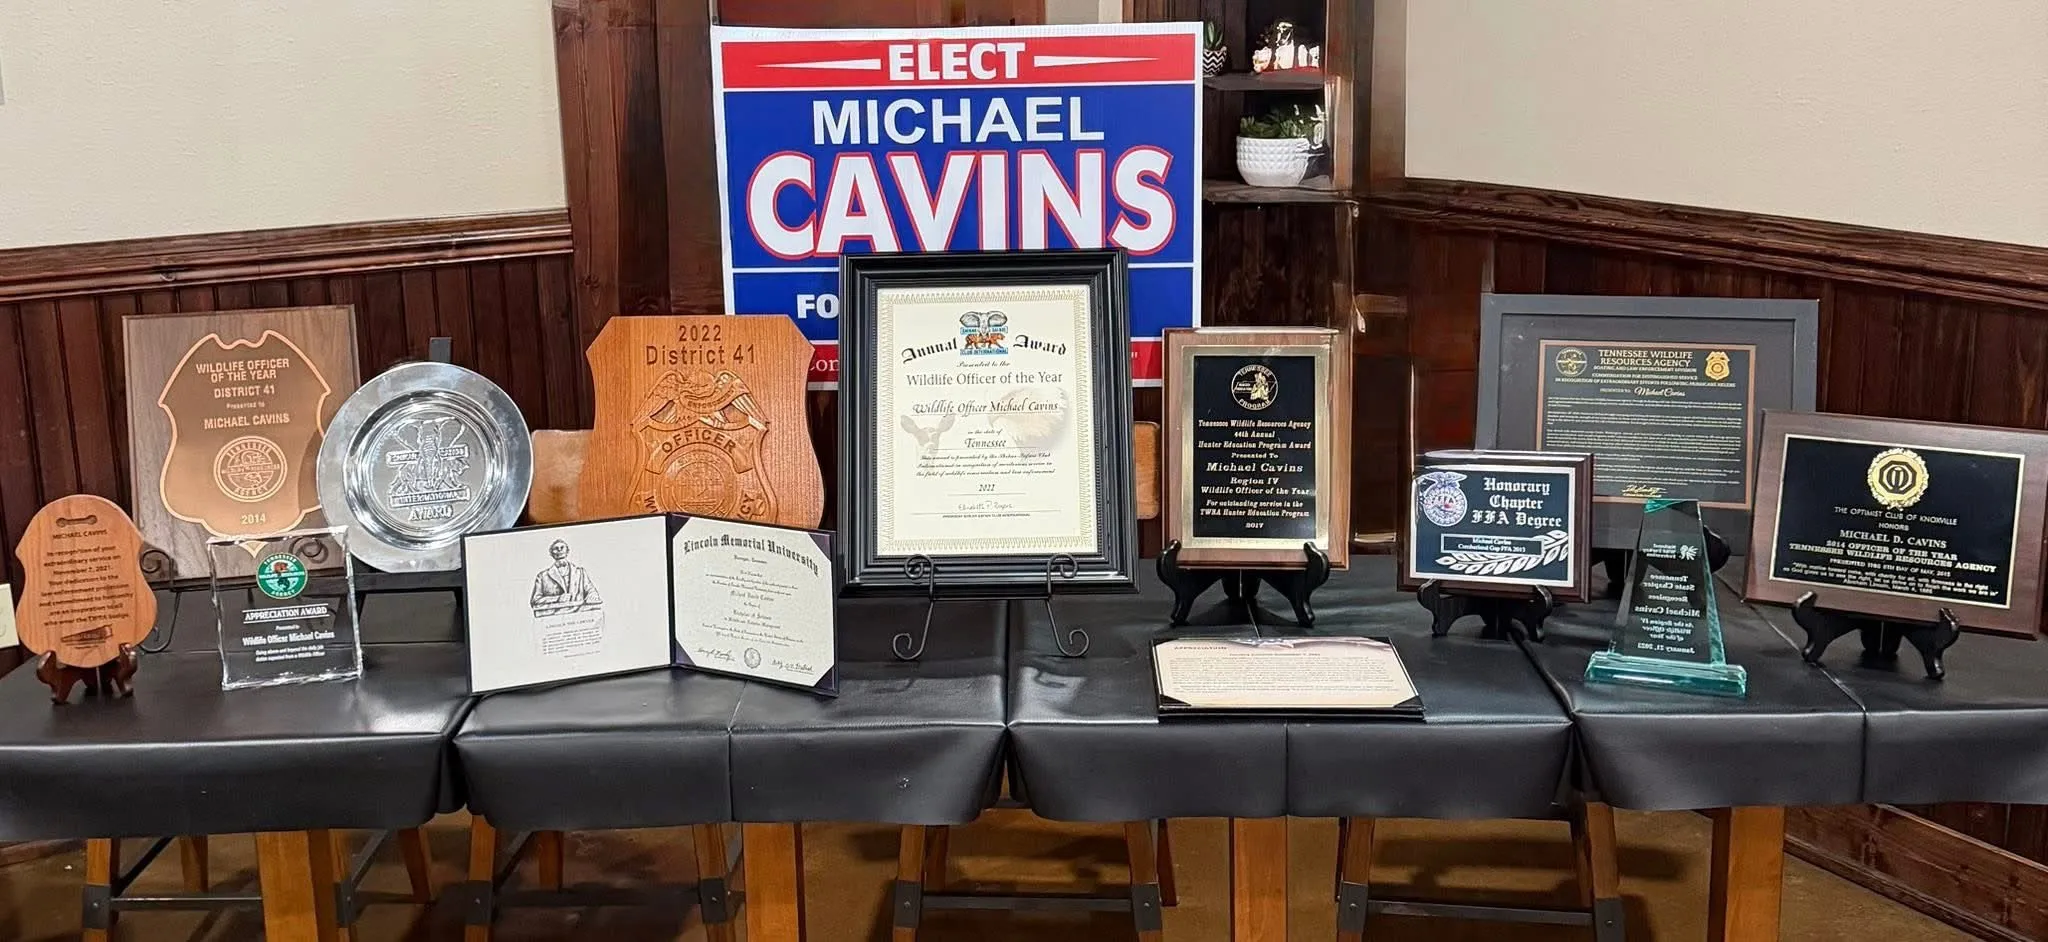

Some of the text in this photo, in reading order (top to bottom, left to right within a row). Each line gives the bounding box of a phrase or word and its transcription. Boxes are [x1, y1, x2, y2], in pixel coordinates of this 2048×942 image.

[889, 42, 1025, 80] ELECT
[813, 96, 1105, 145] MICHAEL
[746, 145, 1177, 261] CAVINS
[797, 293, 839, 319] FO
[678, 325, 722, 342] 2022
[646, 344, 756, 365] District 41
[901, 334, 1067, 365] Annual Award
[1598, 349, 1693, 359] TENNESSEE WILDLIFE
[196, 358, 290, 374] WILDLIFE OFFICER
[1600, 358, 1691, 367] RESOURCES AGENCY
[211, 369, 277, 384] OF THE YEAR
[906, 371, 1063, 386] Wildlife Officer of the Year
[214, 385, 275, 398] DISTRICT 41
[912, 397, 1059, 418] Wildlife Officer Michael Cavins
[204, 413, 290, 430] MICHAEL CAVINS
[1198, 419, 1311, 429] Tennessee Wildlife Resources Agency
[662, 428, 737, 454] OFFICER
[1251, 430, 1276, 438] Annual
[964, 438, 1007, 448] Tennessee
[1198, 440, 1312, 450] Hunter Education Program Award
[1206, 462, 1303, 473] Michael Cavins
[1230, 477, 1280, 486] Region IV
[1483, 477, 1551, 496] Honorary
[1200, 486, 1233, 494] Wildlife
[1235, 487, 1264, 495] Officer
[1265, 487, 1274, 495] of
[1276, 487, 1289, 495] the
[1219, 500, 1258, 508] outstanding
[1489, 494, 1544, 511] Chapter
[240, 514, 266, 525] 2014
[1281, 510, 1310, 518] Program
[1471, 509, 1562, 529] FFA Degree
[1834, 506, 1848, 514] THE
[1850, 508, 1882, 517] OPTIMIST
[1885, 512, 1904, 520] CLUB
[1919, 515, 1958, 526] KNOXVILLE
[1878, 522, 1910, 531] HONORS
[53, 531, 82, 540] MICHAEL
[1839, 529, 1947, 549] MICHAEL D. CAVINS
[683, 535, 719, 555] Lincoln
[720, 534, 765, 551] Memorial
[767, 539, 819, 578] University
[1789, 543, 1997, 573] TENNESSEE WILDLIFE RESOURCES AGENCY
[1826, 540, 1958, 561] 2014 OFFICER OF THE YEAR
[245, 606, 328, 621] APPRECIATION AWARD
[242, 630, 335, 646] Wildlife Officer Michael Cavins
